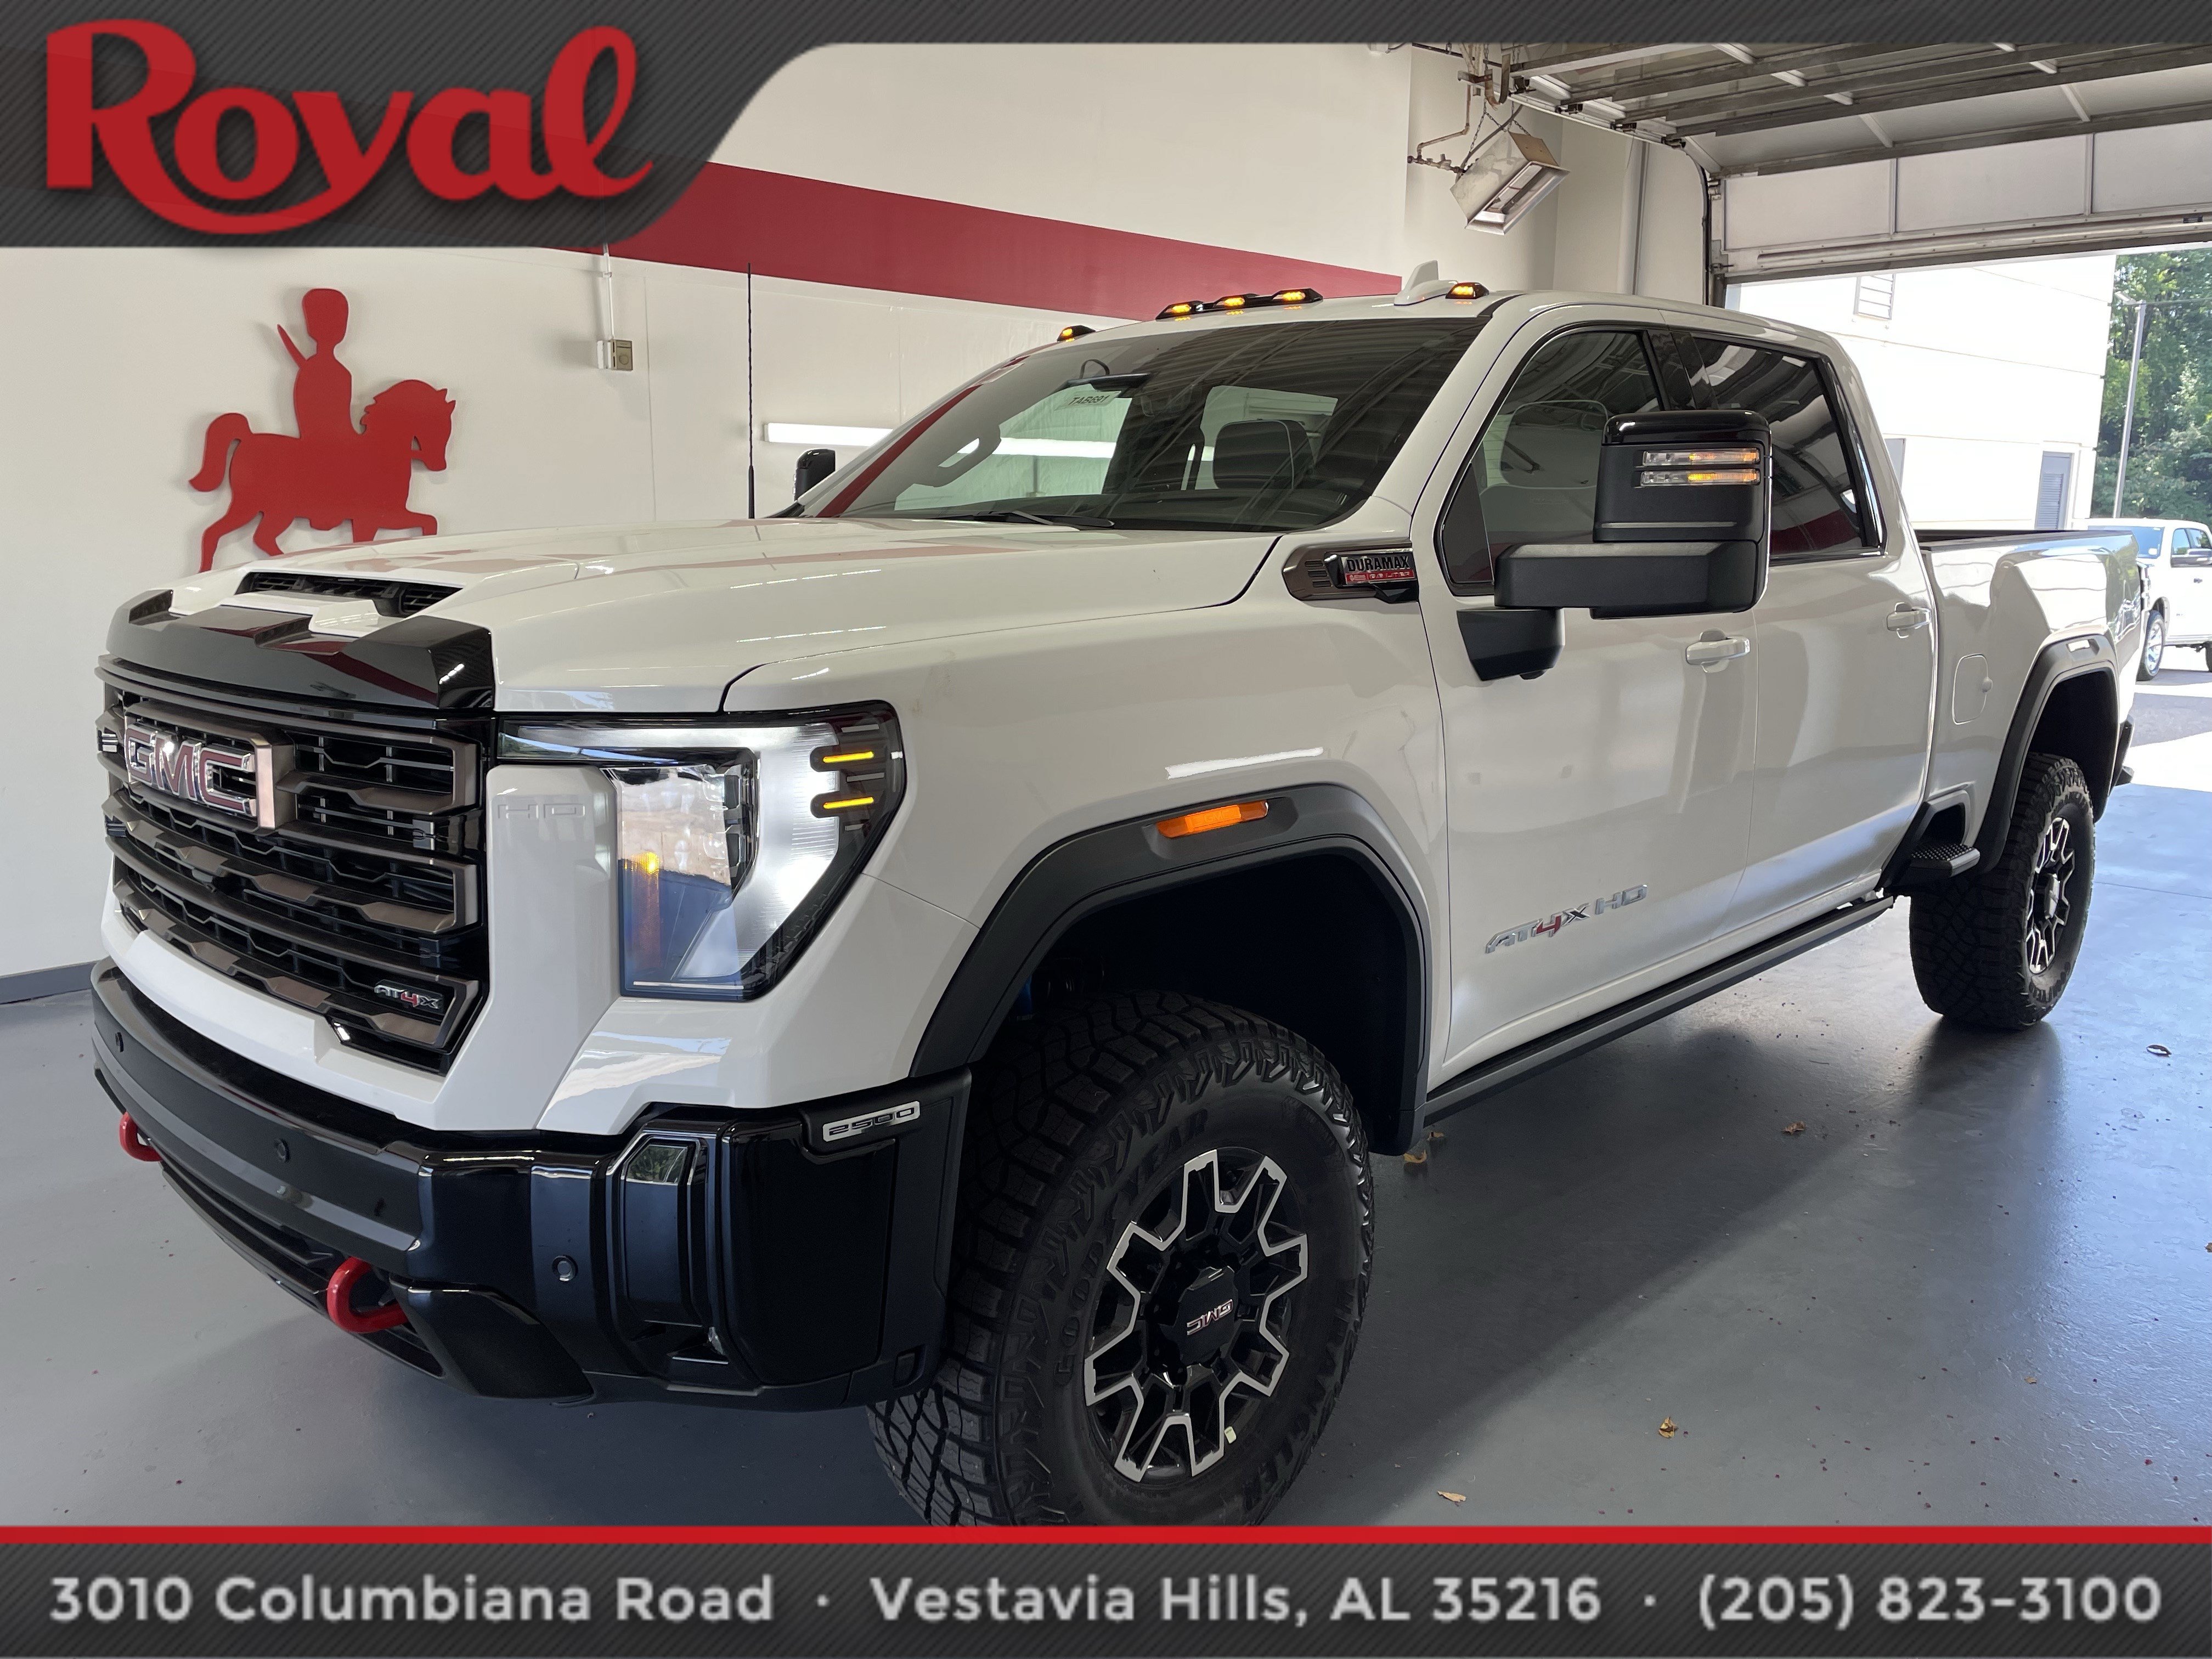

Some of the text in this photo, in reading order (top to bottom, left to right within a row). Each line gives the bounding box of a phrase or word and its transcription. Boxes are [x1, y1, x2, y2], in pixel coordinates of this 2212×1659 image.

[1347, 556, 1410, 572] DURAMAX
[124, 723, 252, 815] GMC
[498, 803, 586, 819] HD
[1485, 884, 1647, 954] AT4X HD
[374, 984, 440, 1009] AT4X
[828, 1107, 915, 1136] 2500
[1187, 1299, 1233, 1336] GMC
